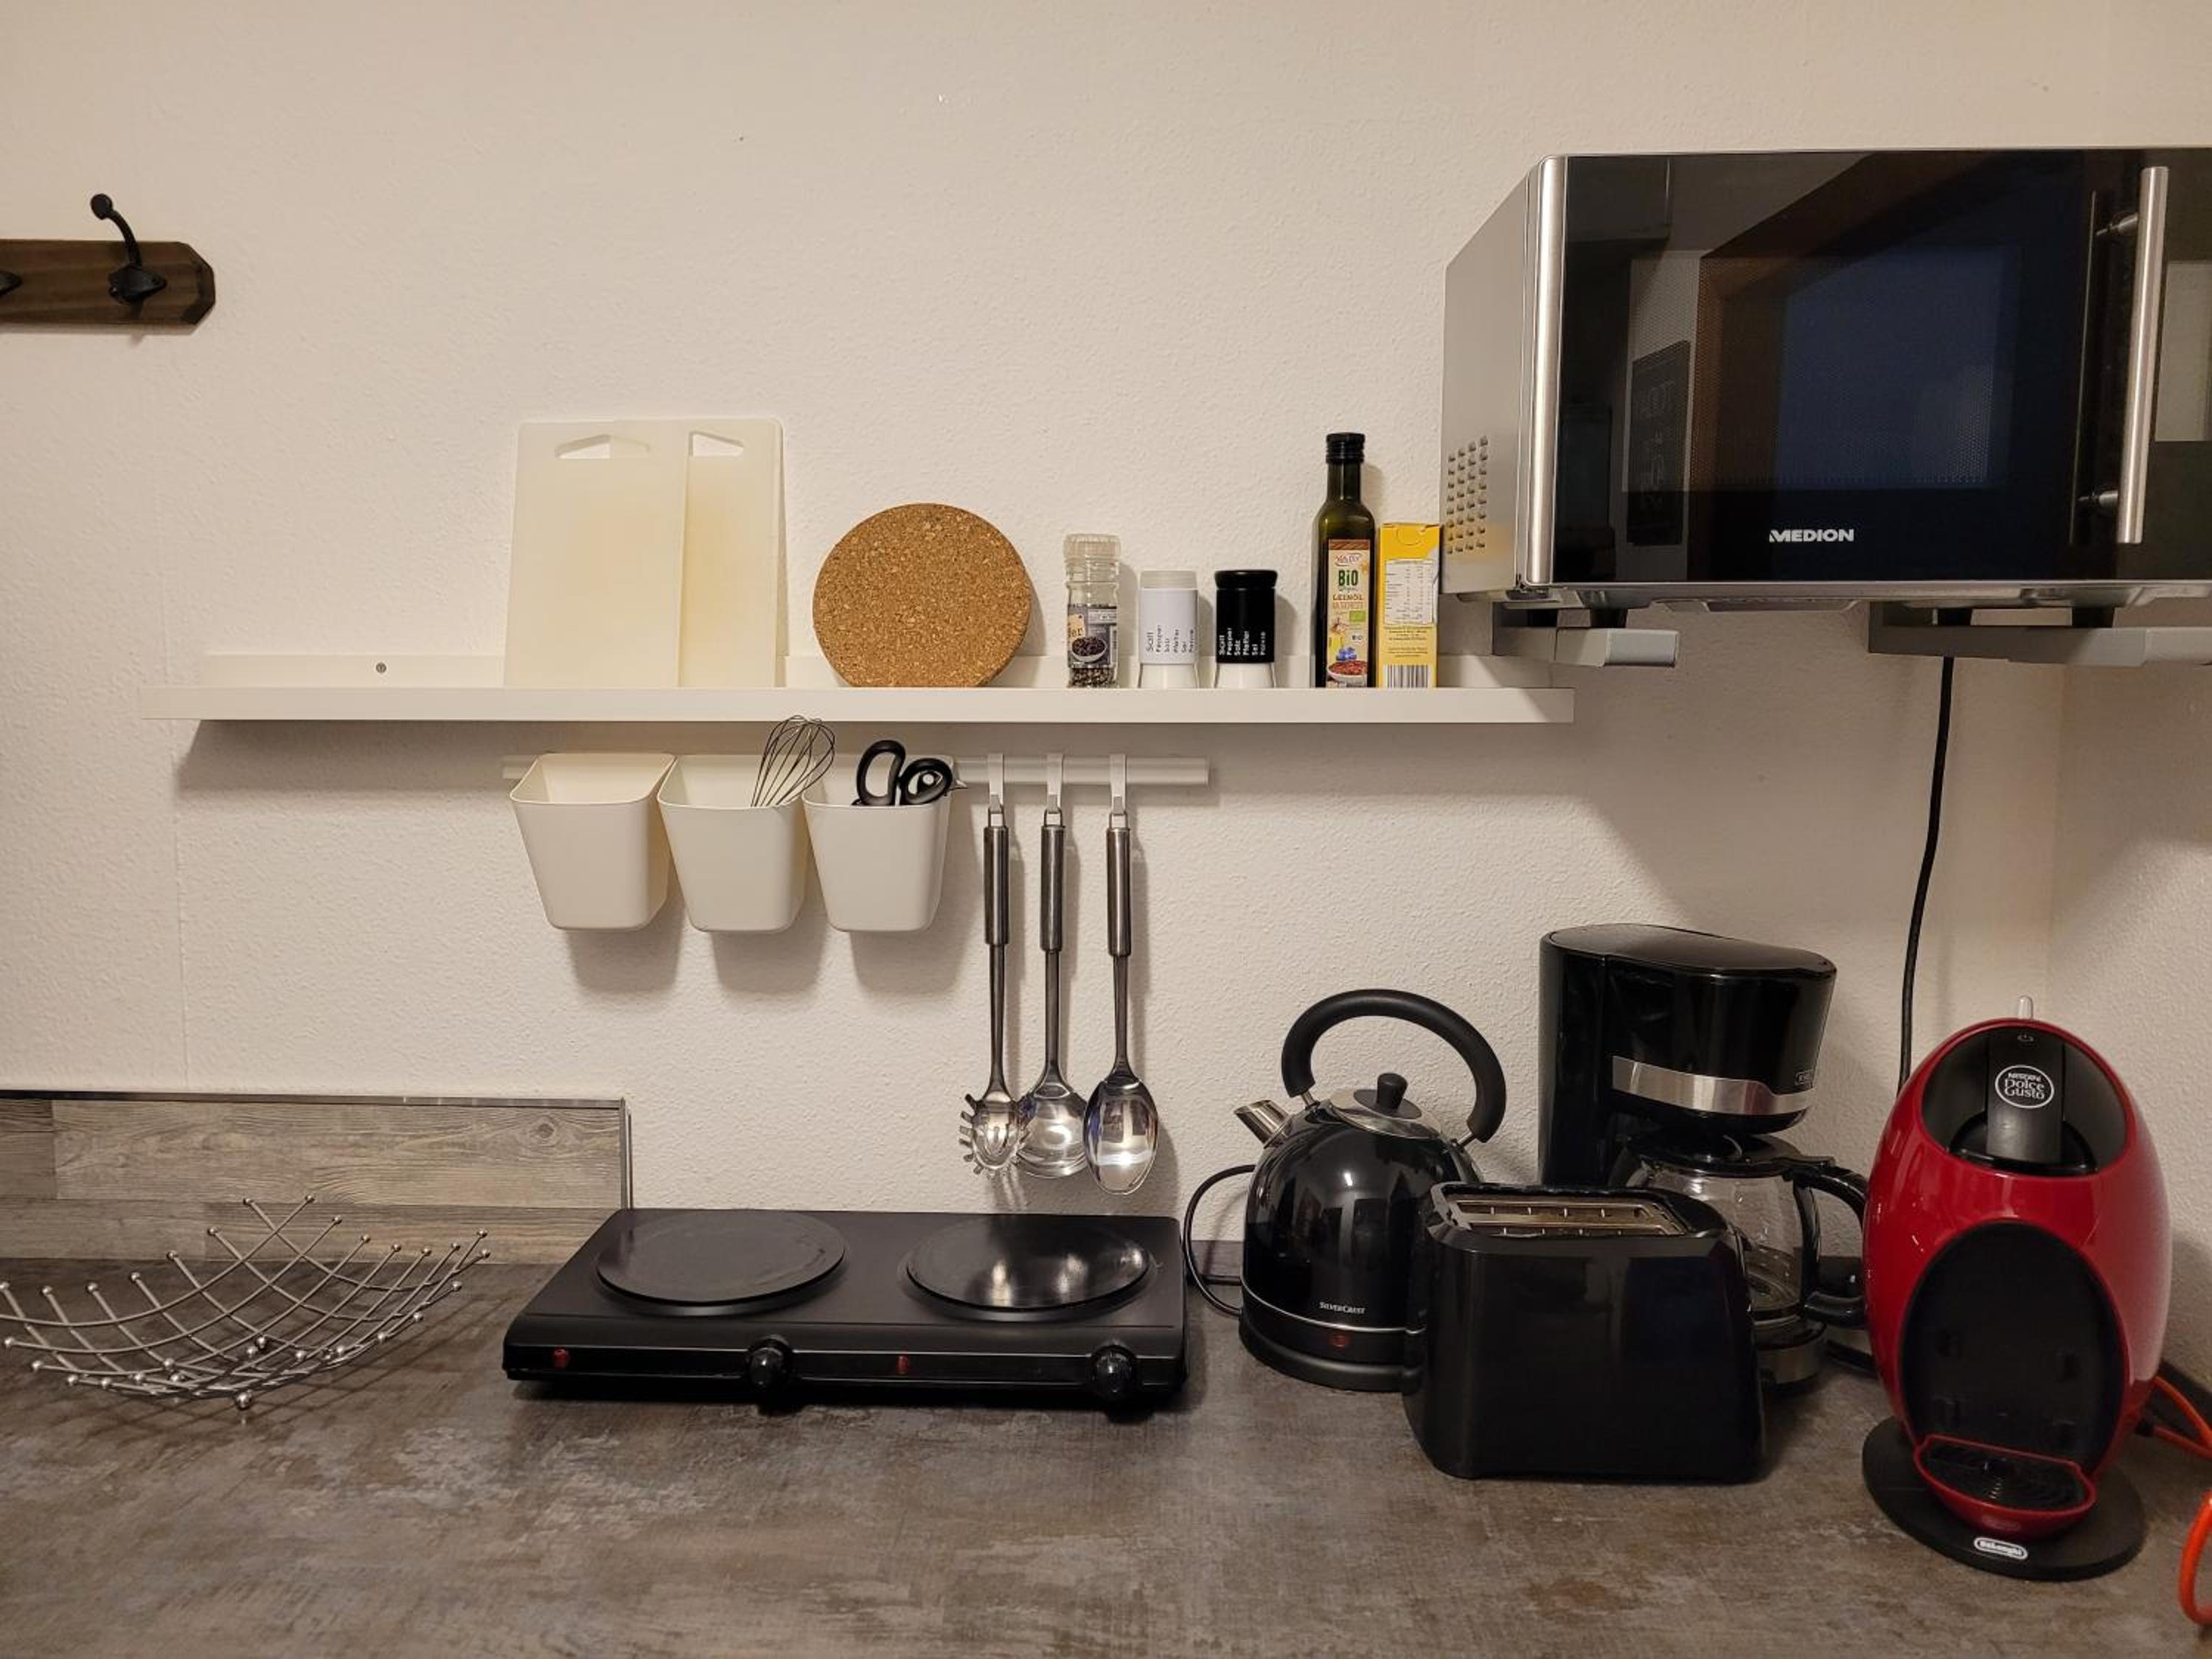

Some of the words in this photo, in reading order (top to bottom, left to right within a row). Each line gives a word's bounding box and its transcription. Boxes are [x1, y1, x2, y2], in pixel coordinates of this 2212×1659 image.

[1769, 529, 1854, 543] MEDION
[2005, 1079, 2045, 1092] Dolce
[2004, 1087, 2045, 1099] Gusto
